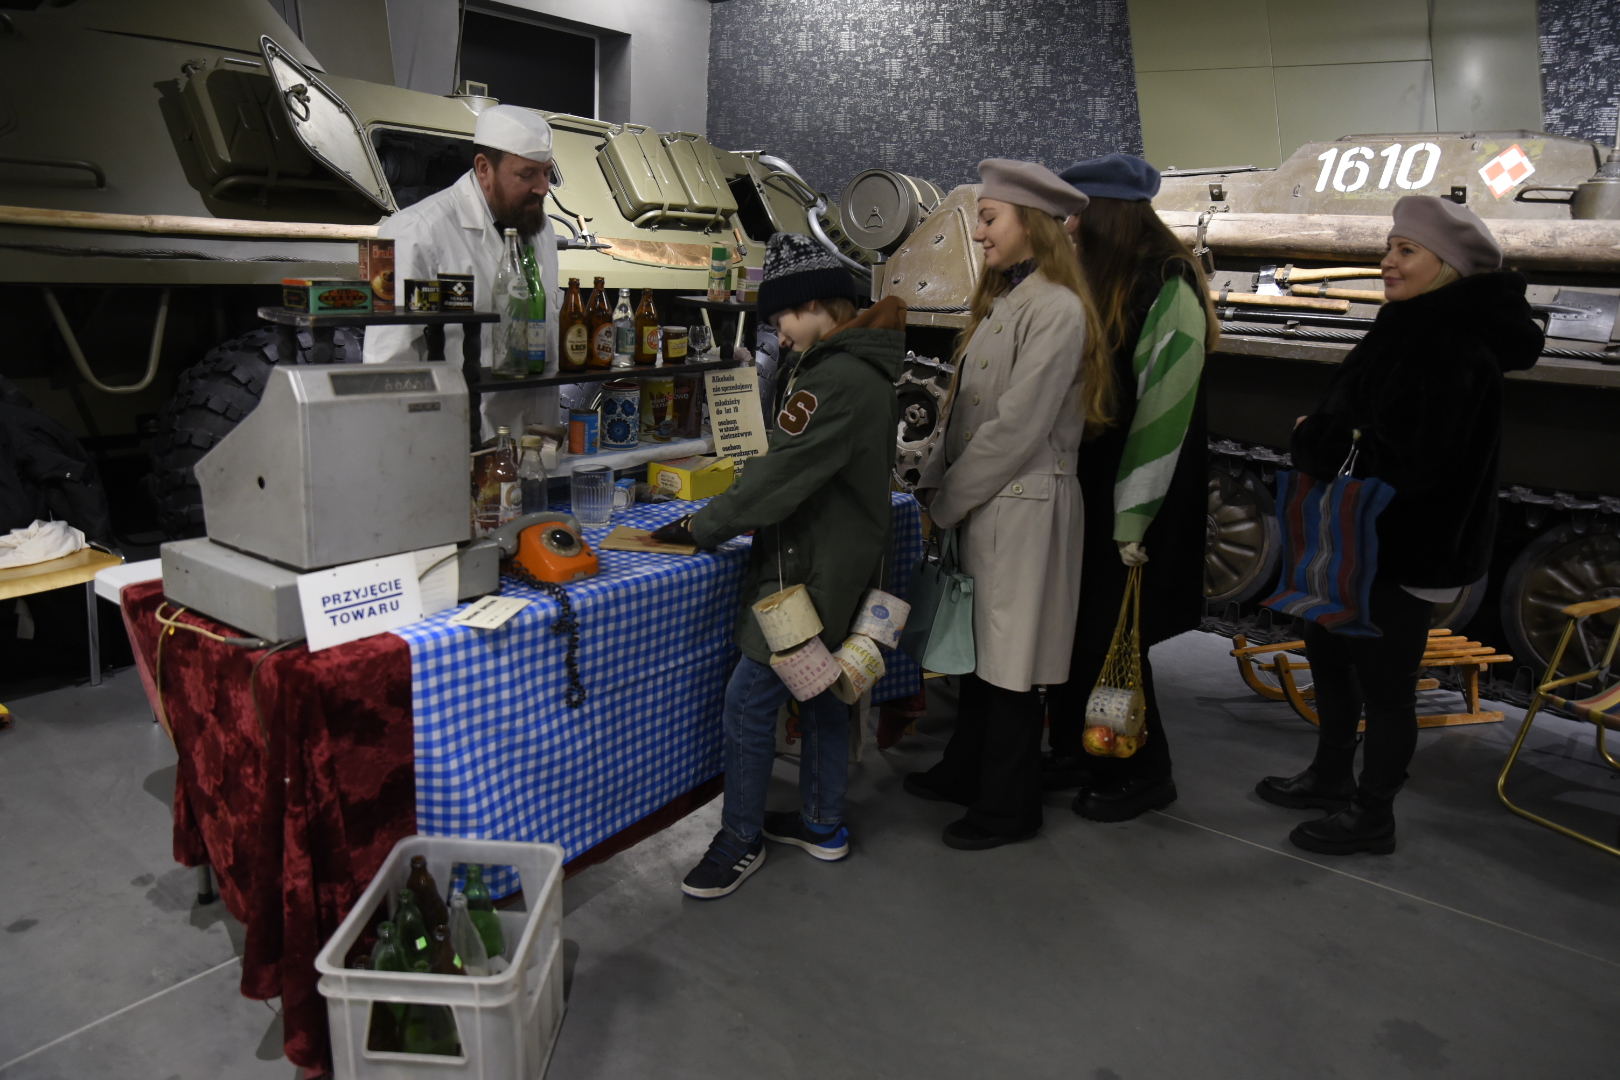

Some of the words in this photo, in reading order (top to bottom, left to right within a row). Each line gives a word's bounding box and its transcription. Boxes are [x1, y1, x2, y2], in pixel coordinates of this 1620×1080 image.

[1314, 142, 1442, 193] 1610
[712, 375, 735, 383] Alkoholu
[713, 385, 721, 393] nie
[721, 383, 753, 393] sprzedajemy
[715, 398, 740, 407] młodzieży
[777, 389, 818, 436] S
[322, 578, 402, 607] PRZYJĘCIE
[330, 600, 400, 626] TOWARU
